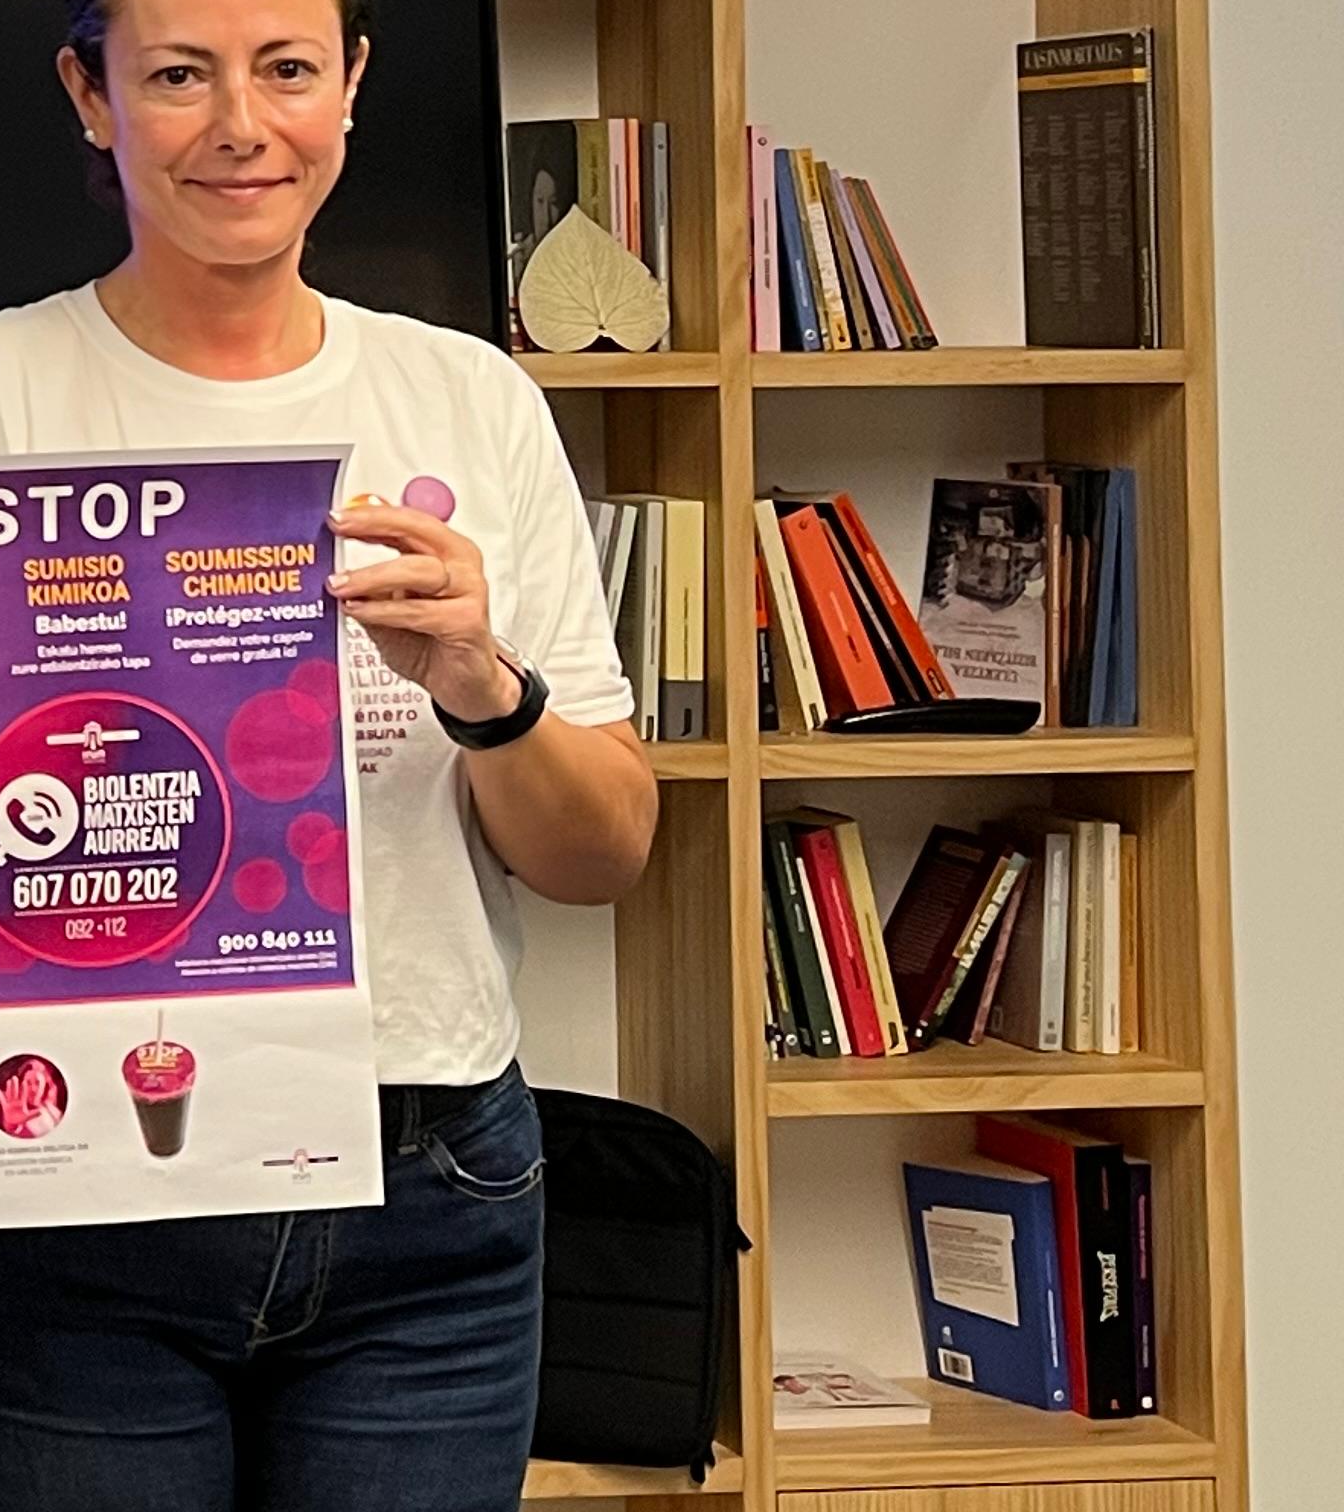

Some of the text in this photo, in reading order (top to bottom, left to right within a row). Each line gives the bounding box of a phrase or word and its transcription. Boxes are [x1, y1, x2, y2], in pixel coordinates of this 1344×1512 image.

[23, 554, 125, 581] SUMISIO
[165, 543, 315, 573] SOUMISSION
[27, 579, 131, 607] KIMIKOA
[183, 569, 302, 598] CHIMIQUE
[35, 610, 128, 635] Babestu!
[83, 770, 201, 803] BIOLENTZIA
[83, 797, 195, 829] MATXISTEN
[83, 825, 179, 855] AURREAN
[13, 867, 178, 909] 607 070 202
[218, 929, 337, 955] 900 840 111
